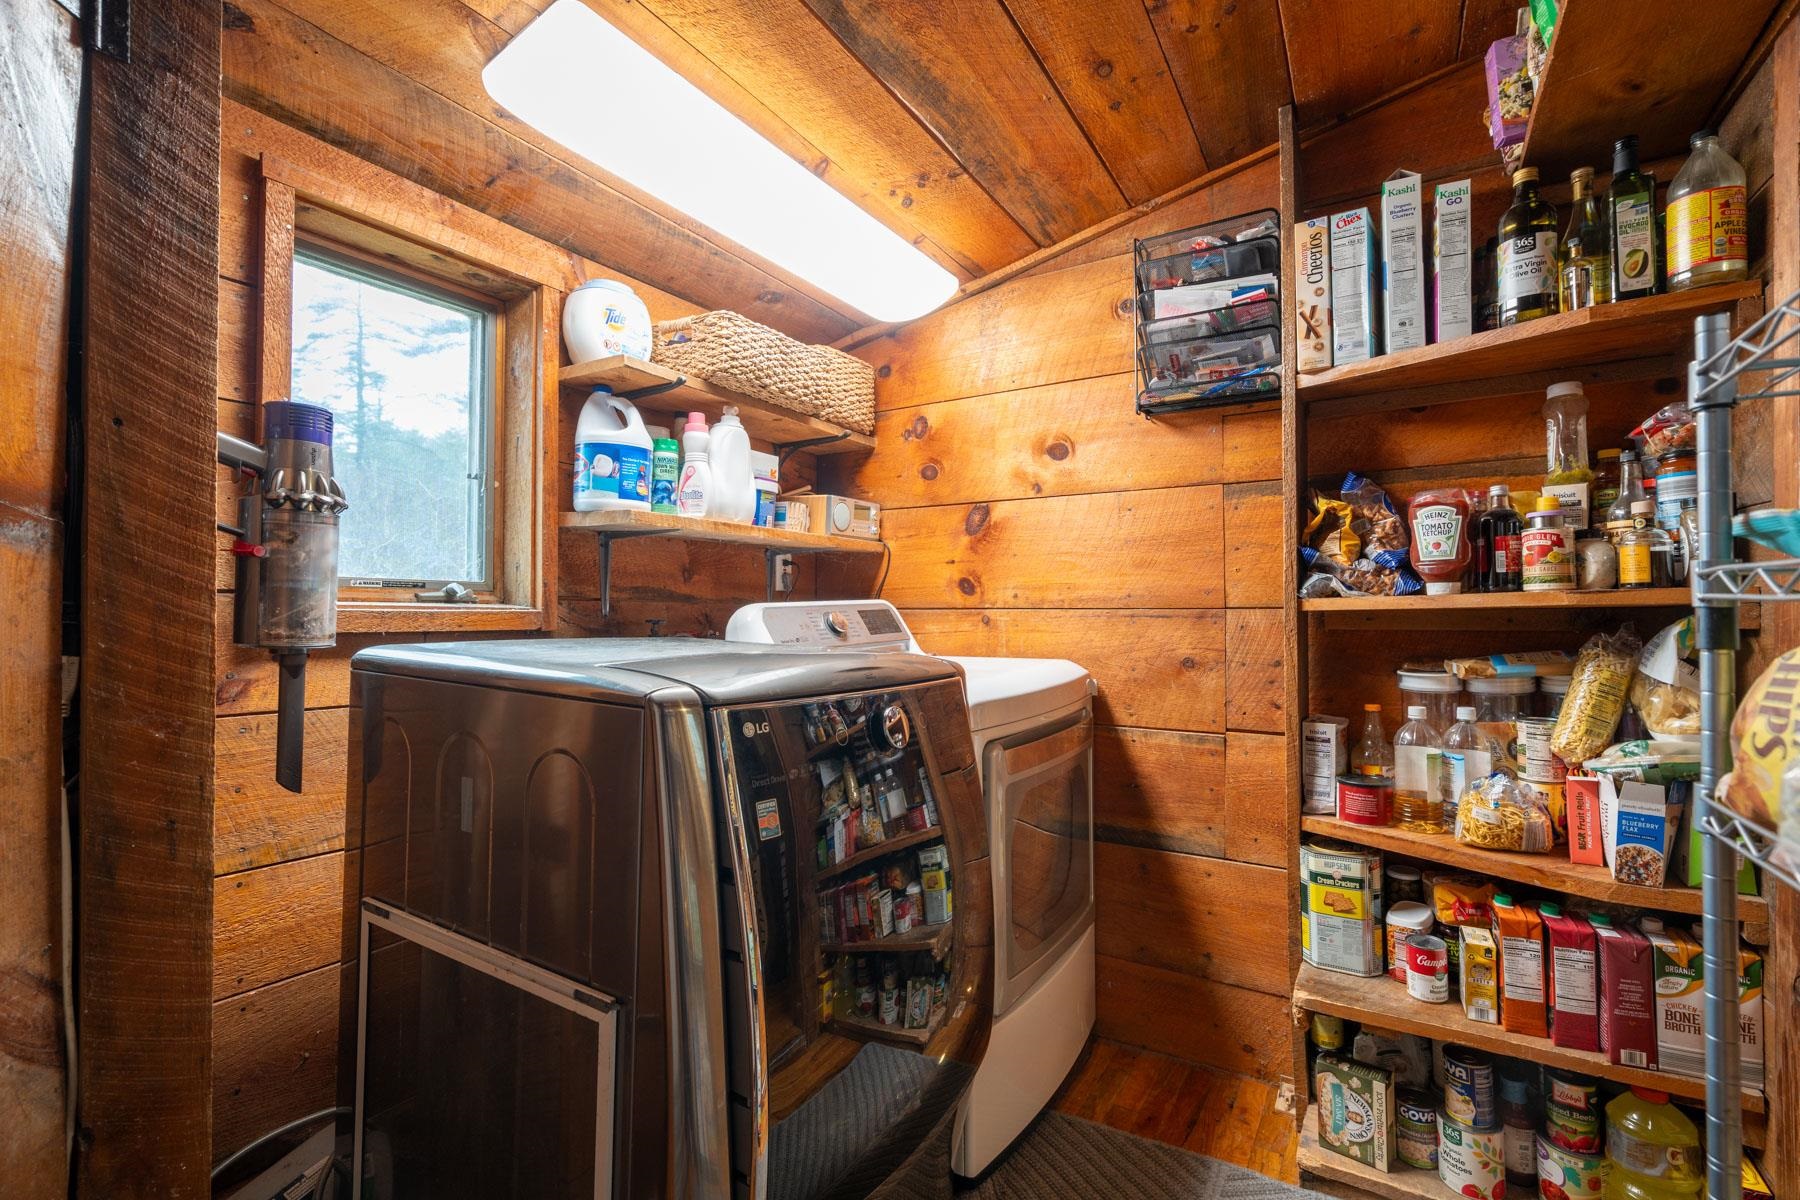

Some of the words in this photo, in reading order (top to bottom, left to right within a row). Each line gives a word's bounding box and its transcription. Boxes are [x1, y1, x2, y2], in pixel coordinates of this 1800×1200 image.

[1388, 183, 1416, 197] Kashi
[1440, 186, 1469, 200] Kashi
[1446, 197, 1463, 206] GO
[1336, 213, 1362, 230] Chex
[1392, 212, 1415, 220] Clusters
[1714, 220, 1742, 229] APPLE
[1724, 227, 1746, 235] VINEG
[1514, 236, 1534, 249] 365
[1307, 231, 1323, 284] Cheerios
[1524, 259, 1548, 268] Virgin
[605, 307, 626, 325] Tide
[1424, 511, 1449, 520] HEINZ
[1421, 522, 1454, 531] TOMATO
[1422, 529, 1452, 537] KETCHUP
[1536, 533, 1557, 541] GLEN
[755, 722, 770, 734] LG
[1576, 791, 1584, 810] Rolls
[1576, 812, 1586, 831] Fruit
[1621, 820, 1659, 831] BLUEBERRY
[1317, 876, 1335, 886] Cream
[1334, 878, 1360, 889] Crackers
[1665, 965, 1696, 976] ORGANIC
[1666, 1002, 1698, 1014] CHICKEN
[1665, 1009, 1700, 1026] BONE
[1665, 1020, 1702, 1036] BROTH
[1400, 1106, 1436, 1122] GOYA
[1443, 1125, 1461, 1140] 365
[1442, 1149, 1466, 1167] Whole
